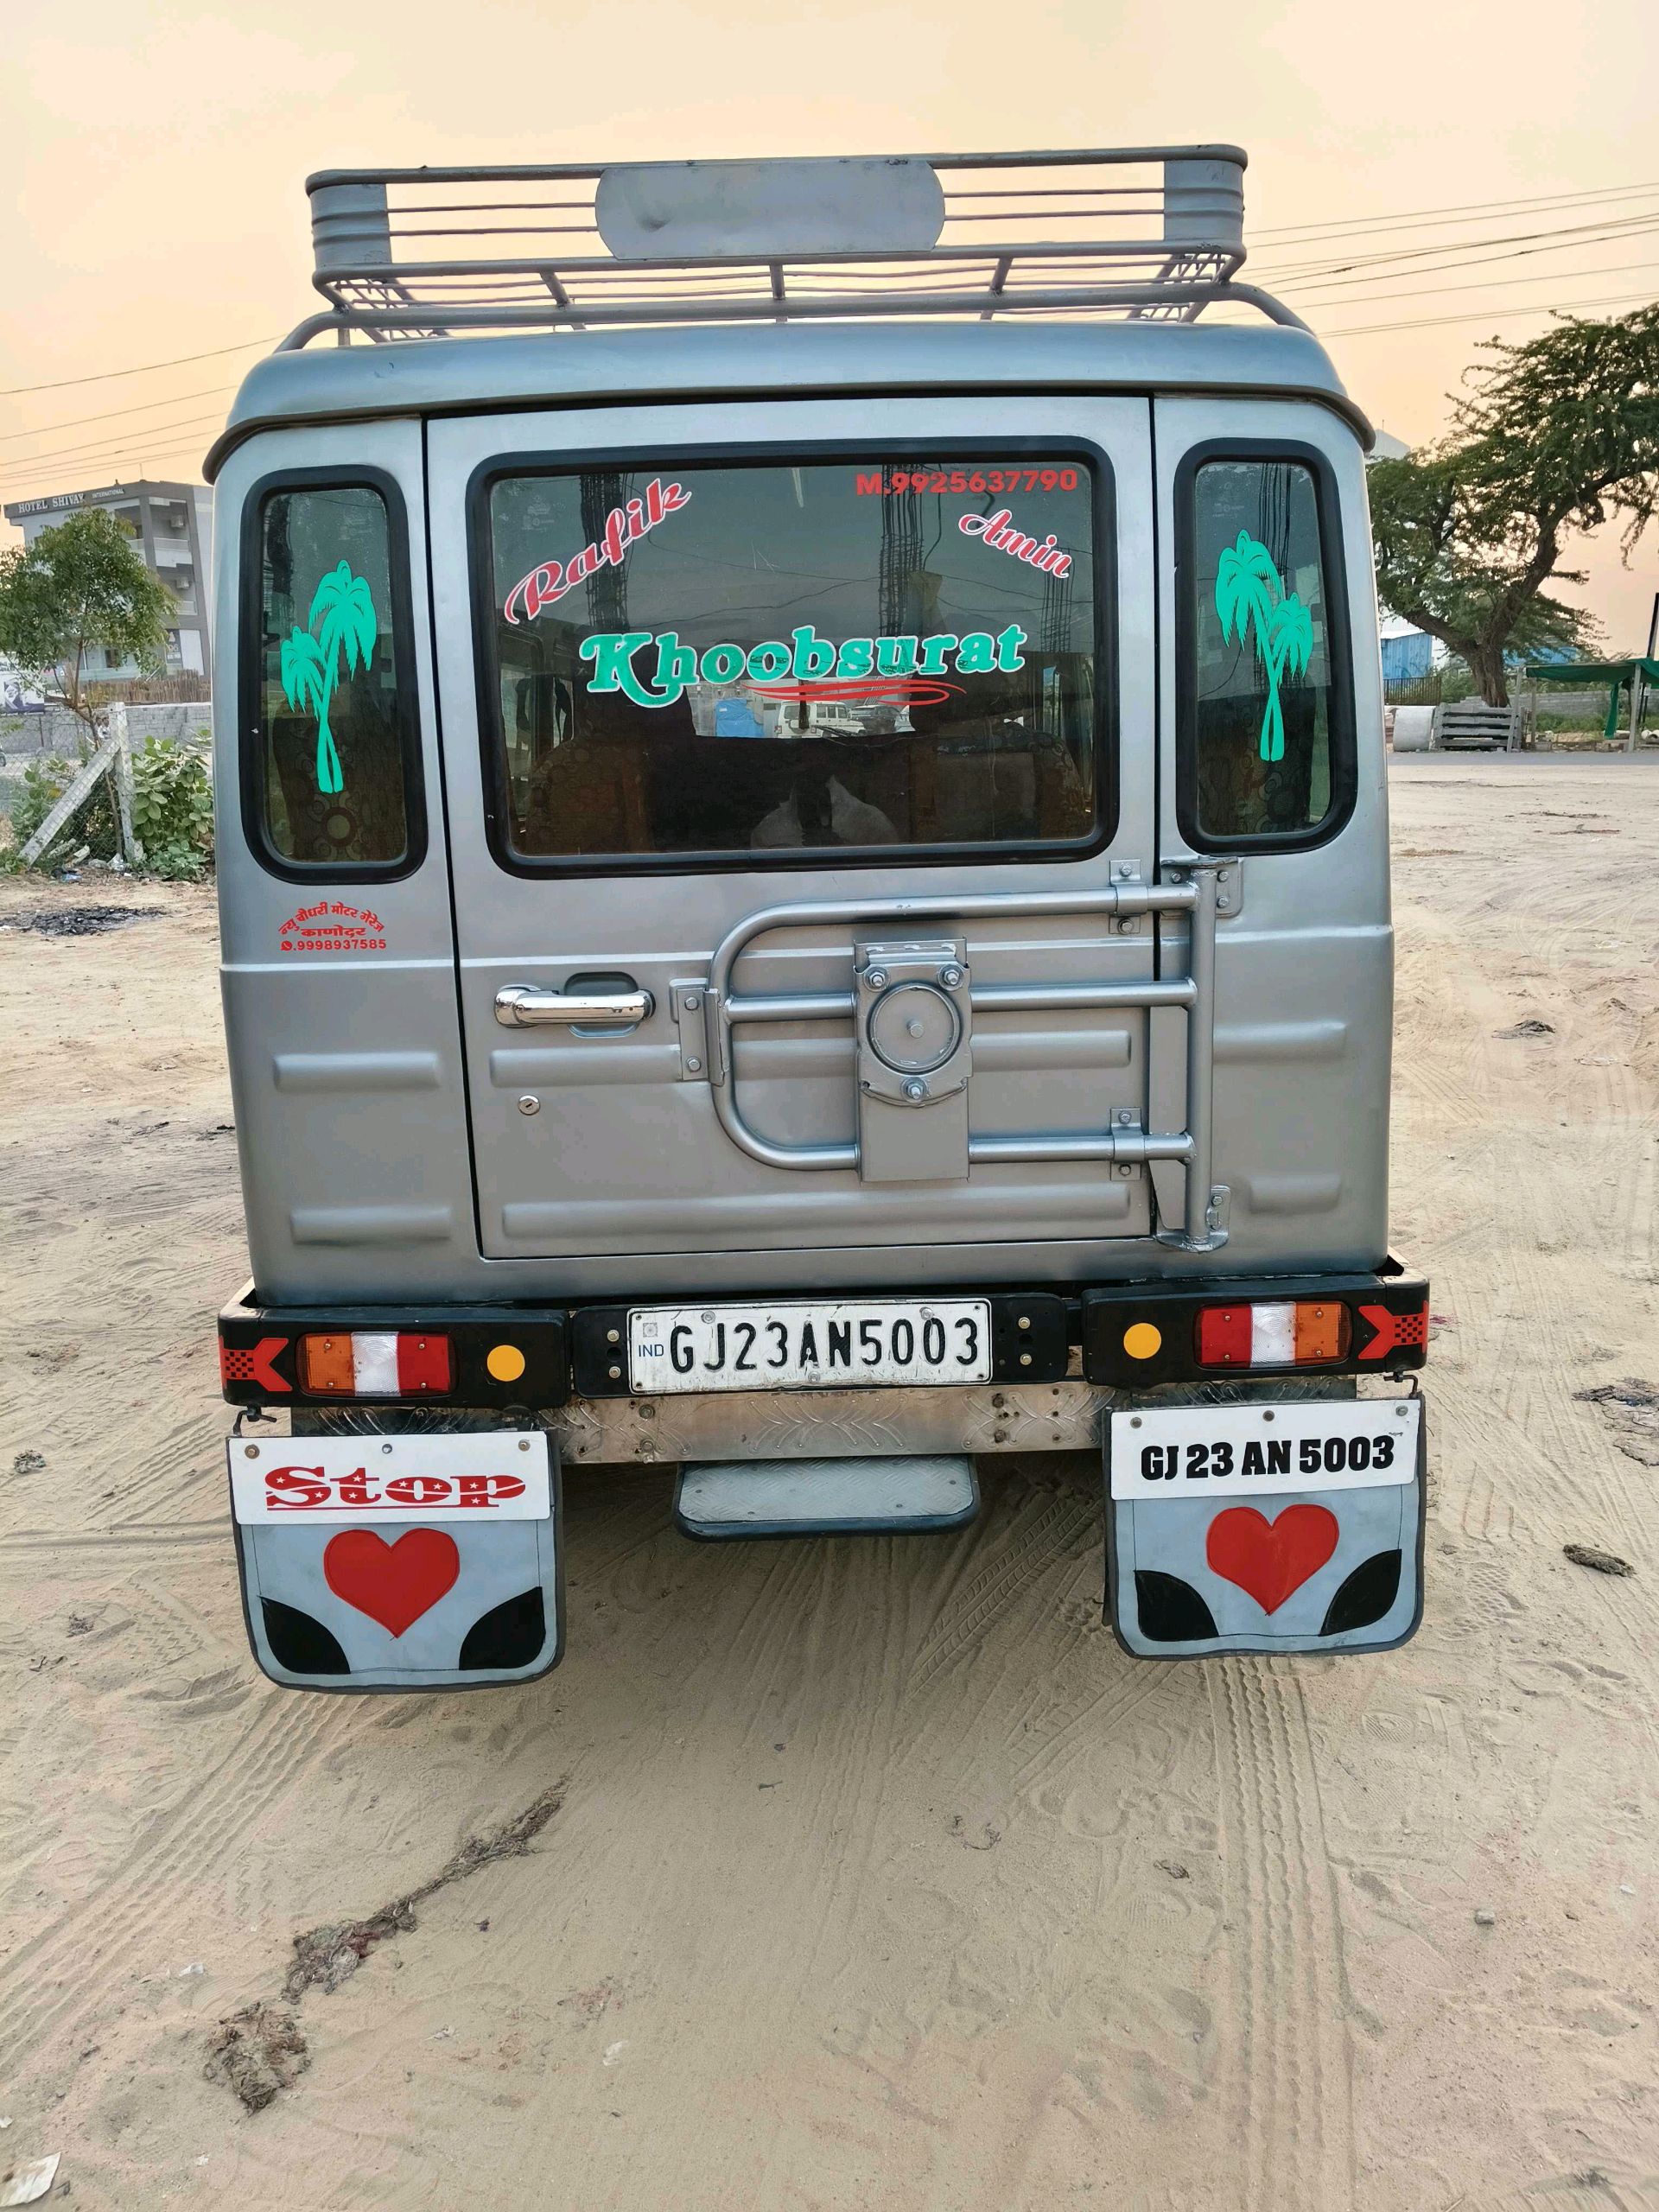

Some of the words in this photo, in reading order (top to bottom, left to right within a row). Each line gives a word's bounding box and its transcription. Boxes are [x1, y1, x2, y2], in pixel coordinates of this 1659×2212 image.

[856, 469, 1078, 496] M.9925637790
[18, 499, 48, 513] HOTEL
[505, 477, 692, 626] Rafik
[958, 508, 1072, 579] Amin
[579, 624, 1028, 709] Khoobsurat
[331, 901, 359, 918] मोटर
[638, 1343, 664, 1358] IND
[669, 1316, 979, 1374] GJ23AN5003
[1141, 1445, 1179, 1480] GJ
[1185, 1441, 1235, 1479] 23
[1241, 1440, 1292, 1476] AN
[1300, 1435, 1395, 1474] 5003
[264, 1465, 526, 1508] Stop
